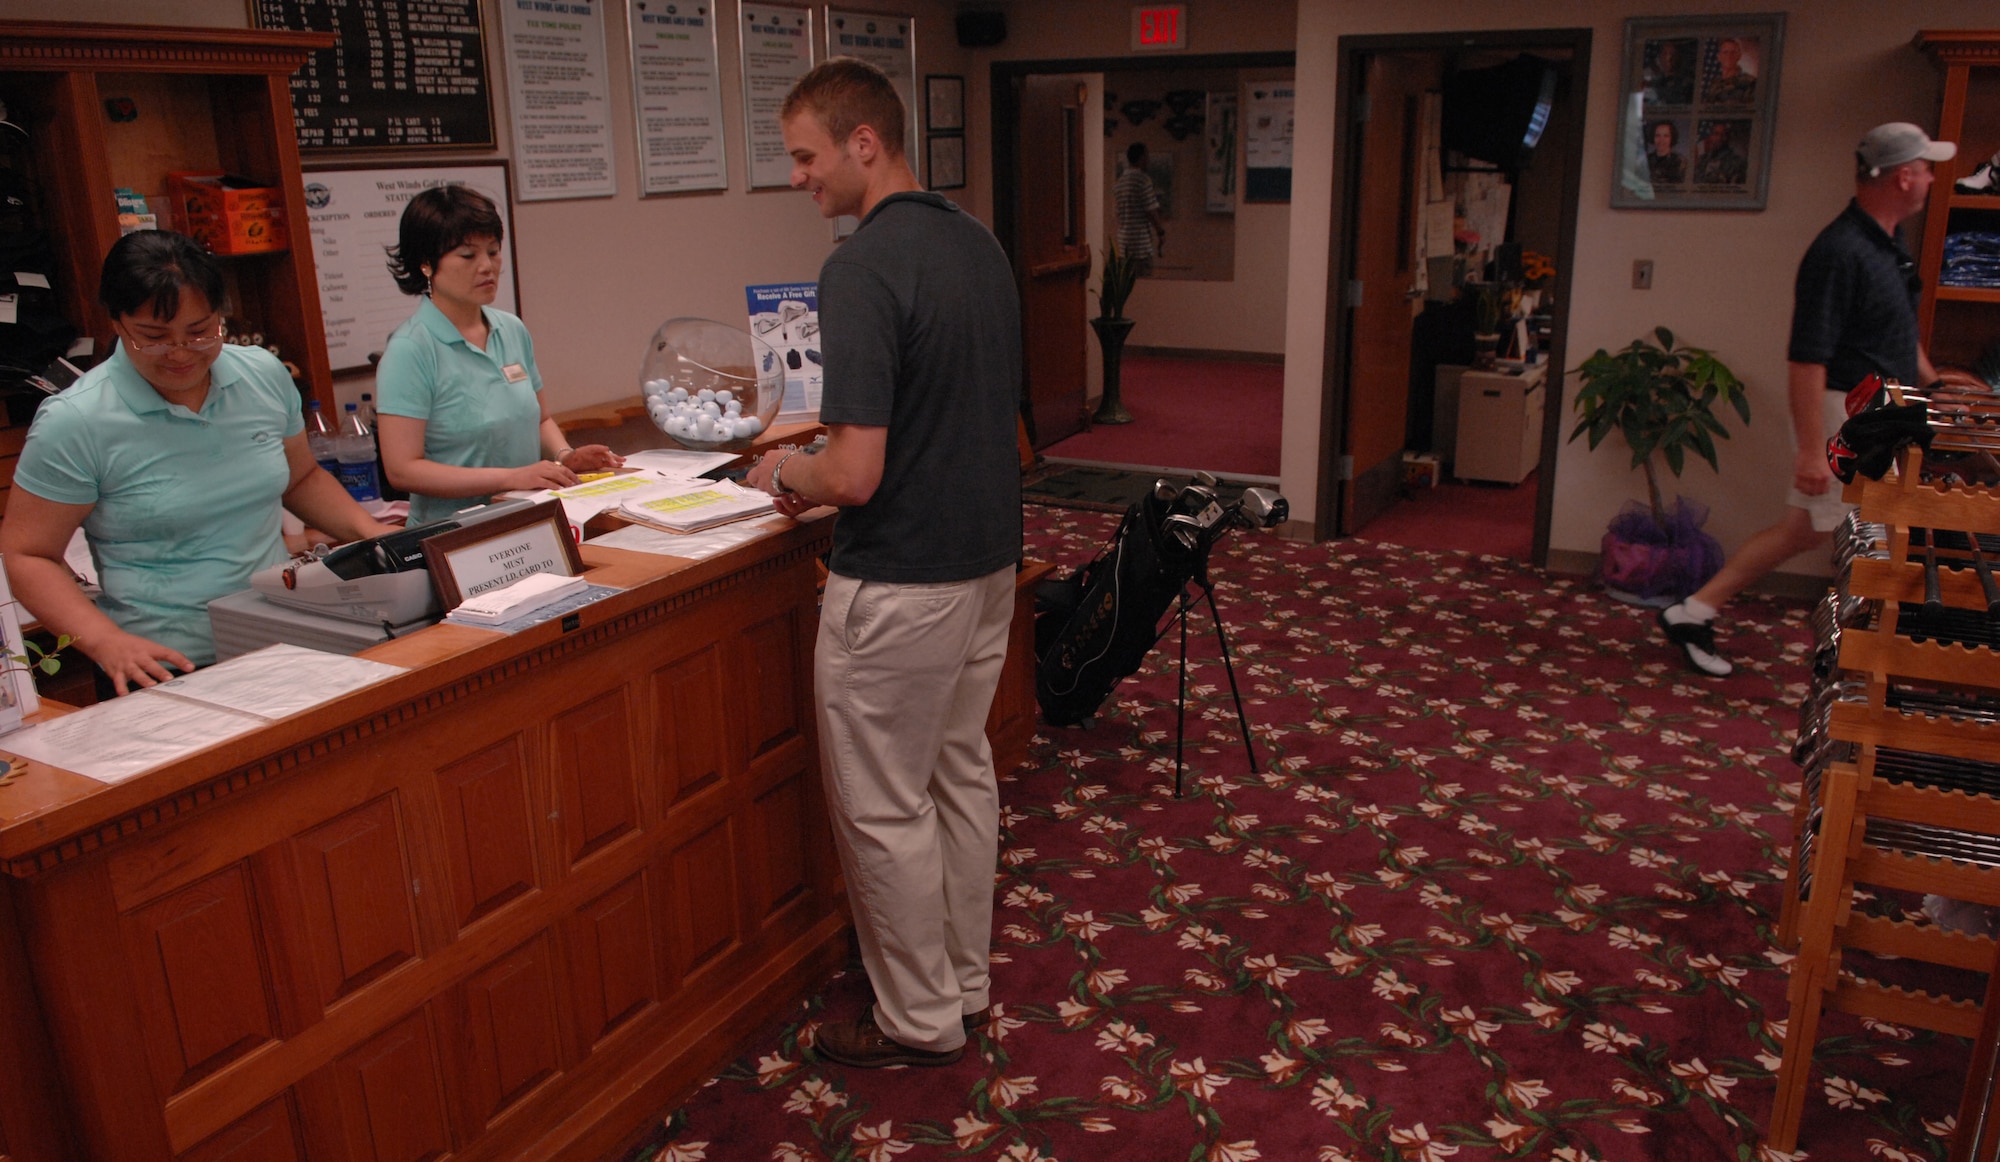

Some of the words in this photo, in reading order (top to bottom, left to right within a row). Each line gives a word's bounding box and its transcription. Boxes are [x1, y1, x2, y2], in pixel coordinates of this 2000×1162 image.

[1140, 8, 1180, 45] EXIT
[376, 181, 396, 190] West
[399, 180, 421, 189] Winds
[422, 178, 440, 188] Golf
[308, 213, 350, 222] ESCRIPTION
[364, 210, 397, 218] ORDERED
[757, 292, 781, 300] Receive
[782, 291, 788, 299] A
[788, 290, 803, 299] Free
[803, 289, 816, 298] Gift
[404, 552, 423, 563] CASIO
[488, 542, 532, 564] EVERYONE
[503, 557, 525, 571] MUST
[468, 575, 505, 596] PRESENT
[518, 563, 542, 579] CARD
[542, 559, 554, 571] TO
